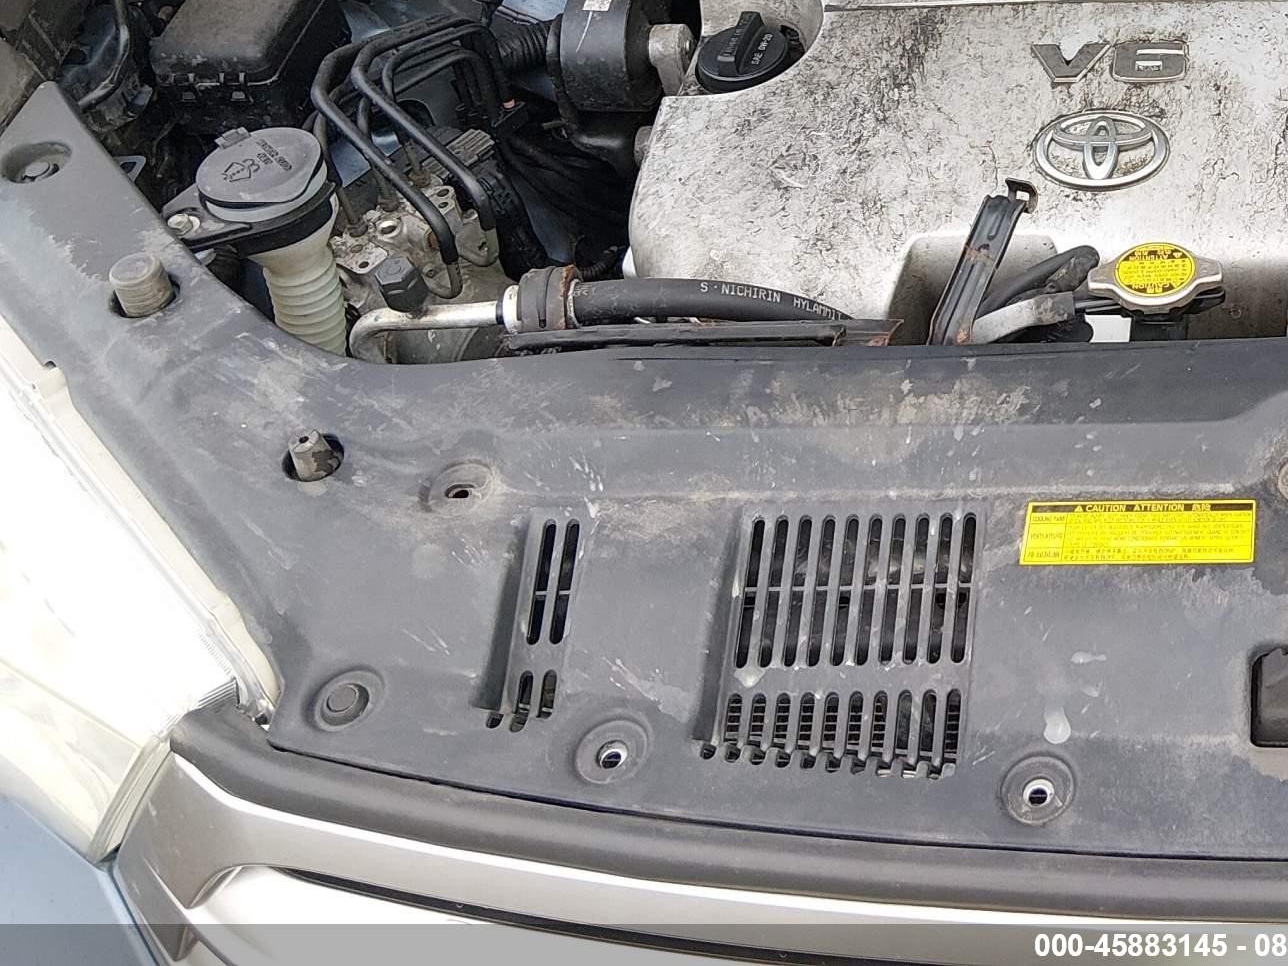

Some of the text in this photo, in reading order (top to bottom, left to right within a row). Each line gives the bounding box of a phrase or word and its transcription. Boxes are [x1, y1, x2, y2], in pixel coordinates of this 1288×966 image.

[1031, 39, 1188, 84] V6
[1085, 503, 1185, 512] CAUTION ATTENTION
